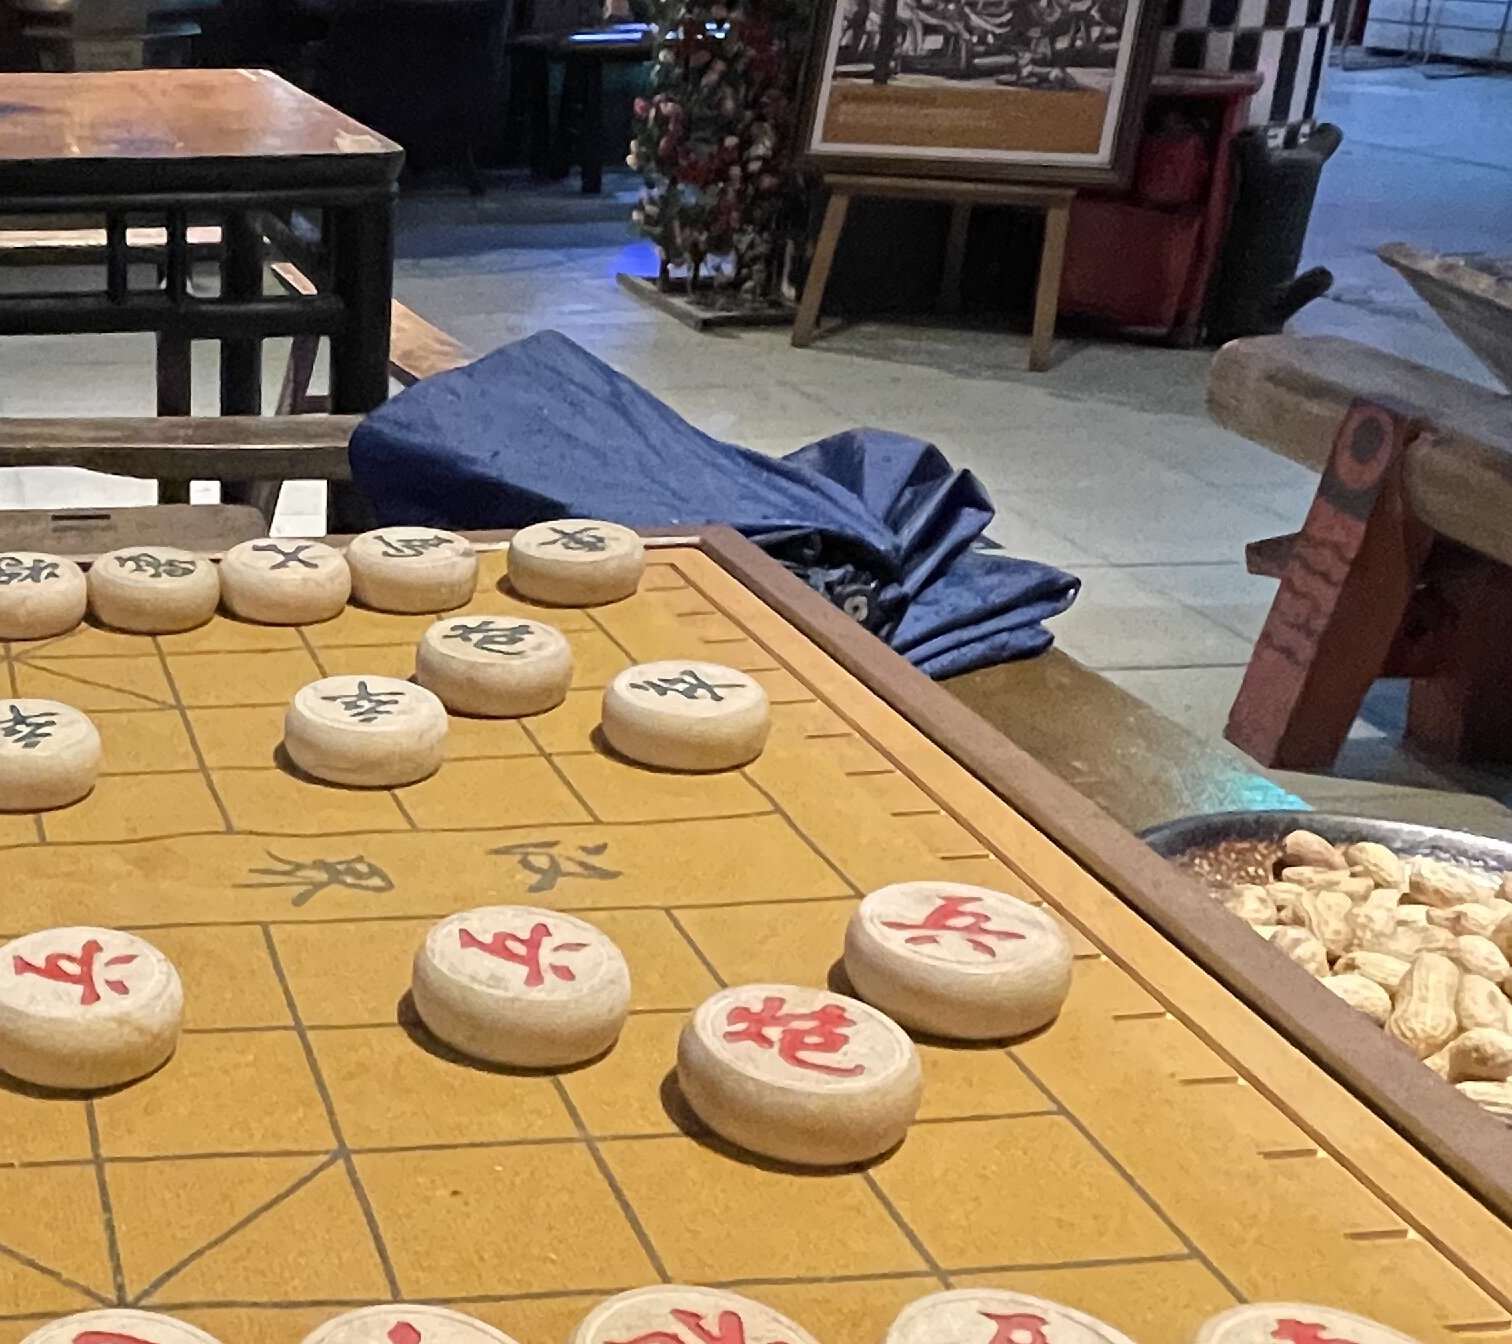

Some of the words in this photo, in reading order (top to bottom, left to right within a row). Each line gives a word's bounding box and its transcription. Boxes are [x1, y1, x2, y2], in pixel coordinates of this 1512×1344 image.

[460, 922, 589, 988] 兵
[883, 896, 1026, 958] 兵
[14, 939, 136, 1005] 兵
